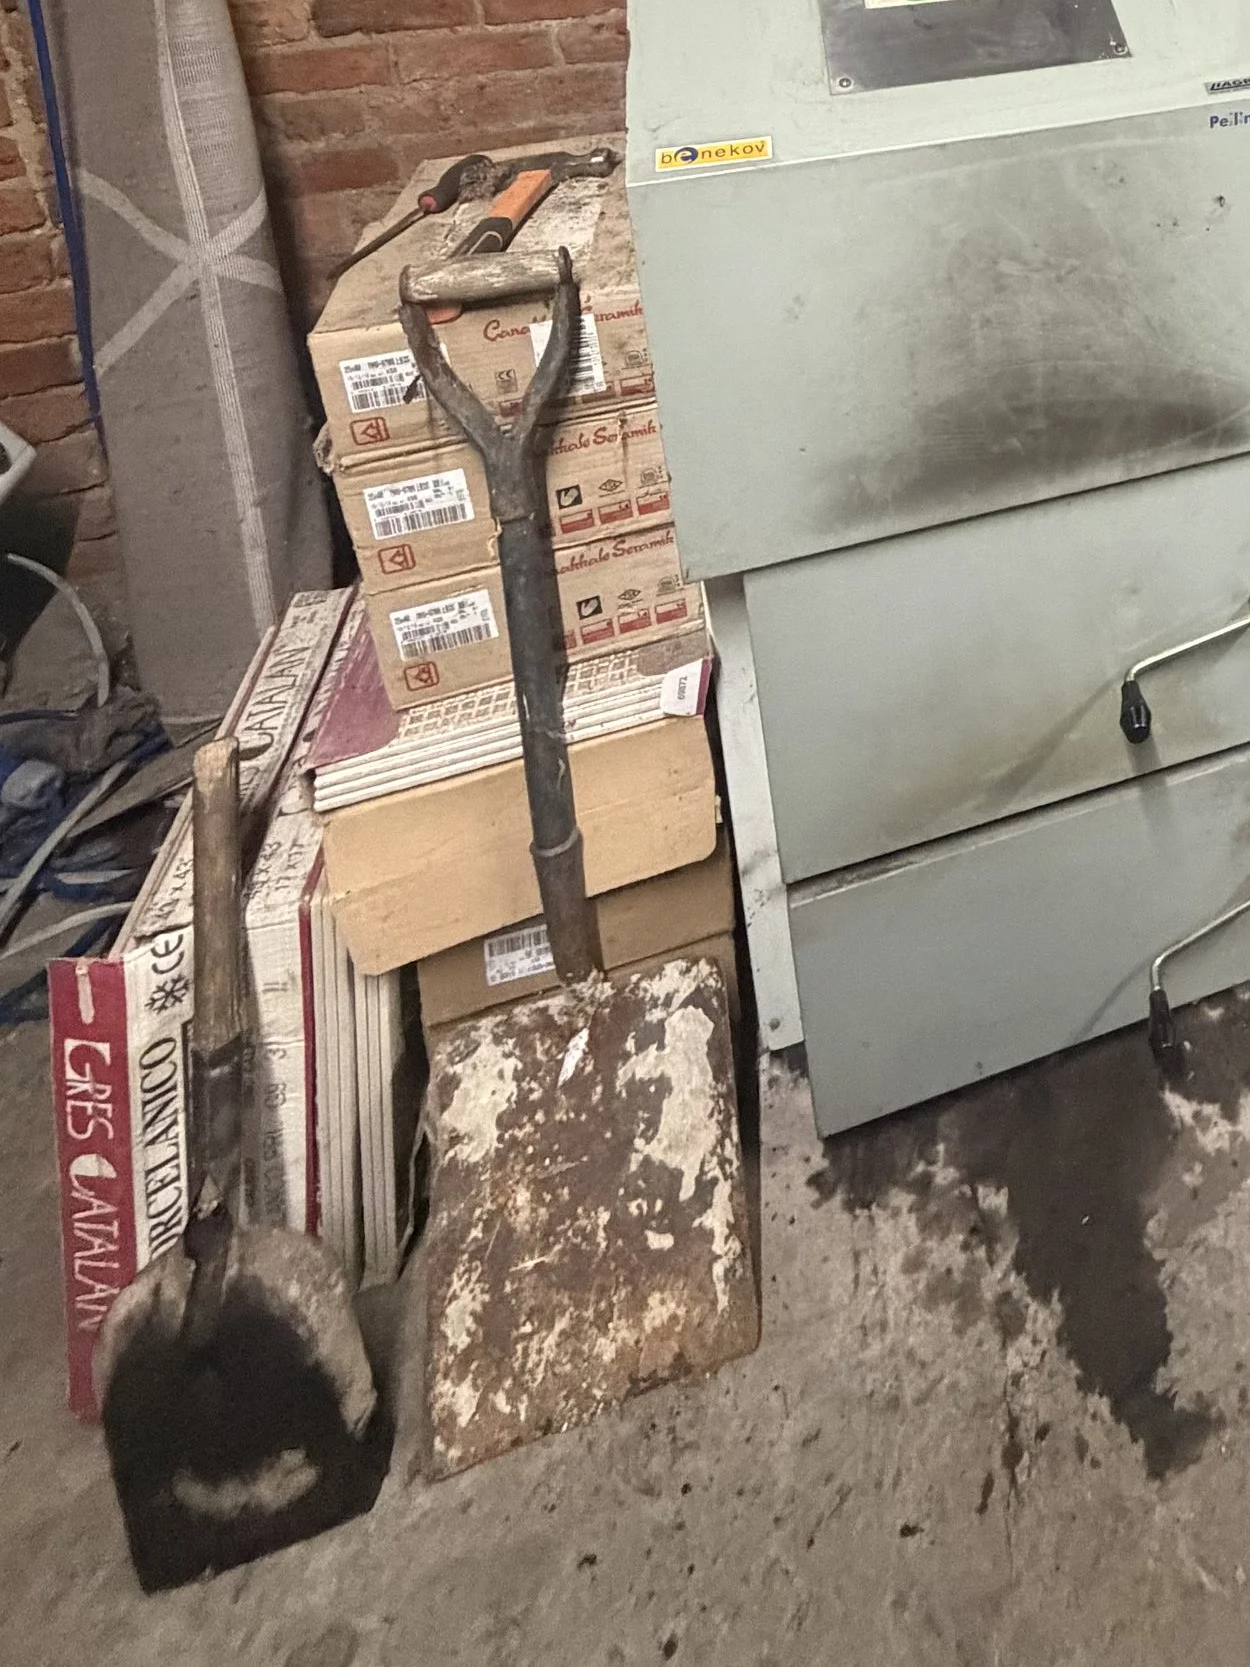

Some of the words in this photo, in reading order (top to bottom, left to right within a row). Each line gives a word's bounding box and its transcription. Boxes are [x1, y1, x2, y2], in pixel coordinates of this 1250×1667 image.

[661, 140, 765, 165] benekov
[612, 530, 675, 558] Seramik
[239, 646, 311, 762] CATALAN
[151, 933, 185, 975] CE
[64, 1037, 115, 1140] GRES
[69, 1153, 121, 1332] CATALAN
